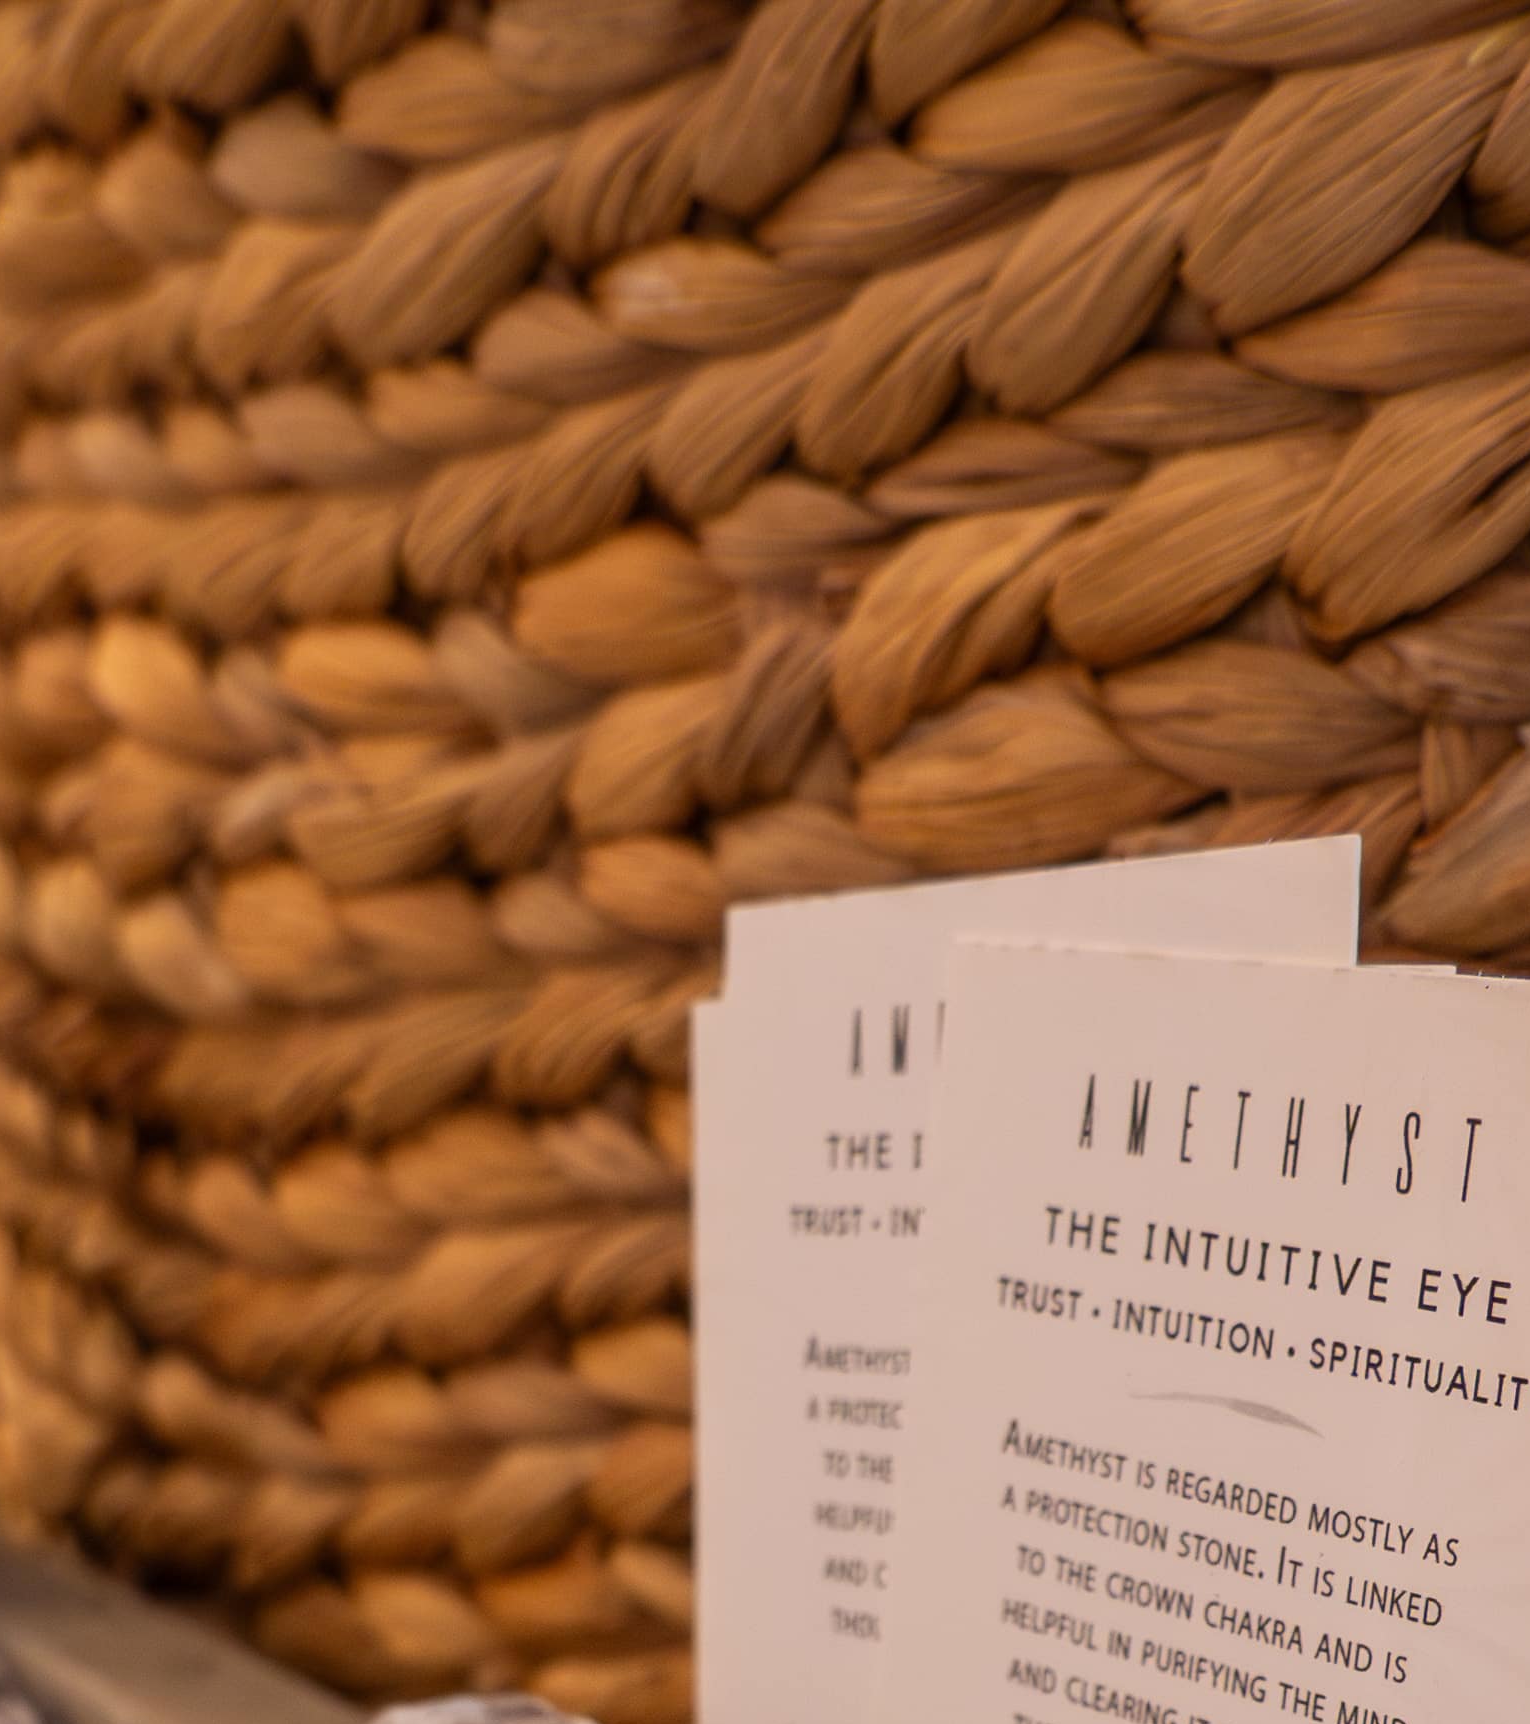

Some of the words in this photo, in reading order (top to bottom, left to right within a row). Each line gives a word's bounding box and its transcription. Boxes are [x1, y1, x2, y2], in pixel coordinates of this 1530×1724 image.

[825, 1131, 893, 1171] THE
[1078, 1073, 1482, 1202] AMETHYST
[790, 1204, 864, 1236] TRUST
[1045, 1206, 1120, 1255] THE
[1143, 1222, 1391, 1303] INTUITIVE
[1417, 1268, 1511, 1325] EYE
[996, 1276, 1083, 1321] TRUST
[1112, 1299, 1274, 1360] INTUITION
[827, 1398, 904, 1430] PROTEC
[1001, 1418, 1127, 1481] AMETHYST
[1137, 1461, 1156, 1489] IS
[1165, 1468, 1297, 1525] REGARDED
[1308, 1503, 1414, 1555] MOSTLY
[1422, 1533, 1460, 1568] AS
[1000, 1485, 1017, 1511] A
[1025, 1489, 1168, 1553] PROTECTION
[1177, 1532, 1265, 1580] STONE.
[1276, 1545, 1303, 1588] IT
[1313, 1566, 1336, 1598] IS
[1345, 1576, 1443, 1628] LINKED
[1016, 1544, 1046, 1577] TO
[1054, 1555, 1097, 1592] THE
[1104, 1571, 1194, 1621] CROWN
[1203, 1600, 1304, 1654] CHAKRA
[1314, 1632, 1374, 1673] AND
[1383, 1650, 1408, 1684] IS
[1000, 1598, 1099, 1651] HELPFUL
[1107, 1631, 1133, 1660] IN
[1140, 1640, 1268, 1704] PURIFYING
[1277, 1681, 1327, 1722] THE
[1006, 1658, 1057, 1694] AND
